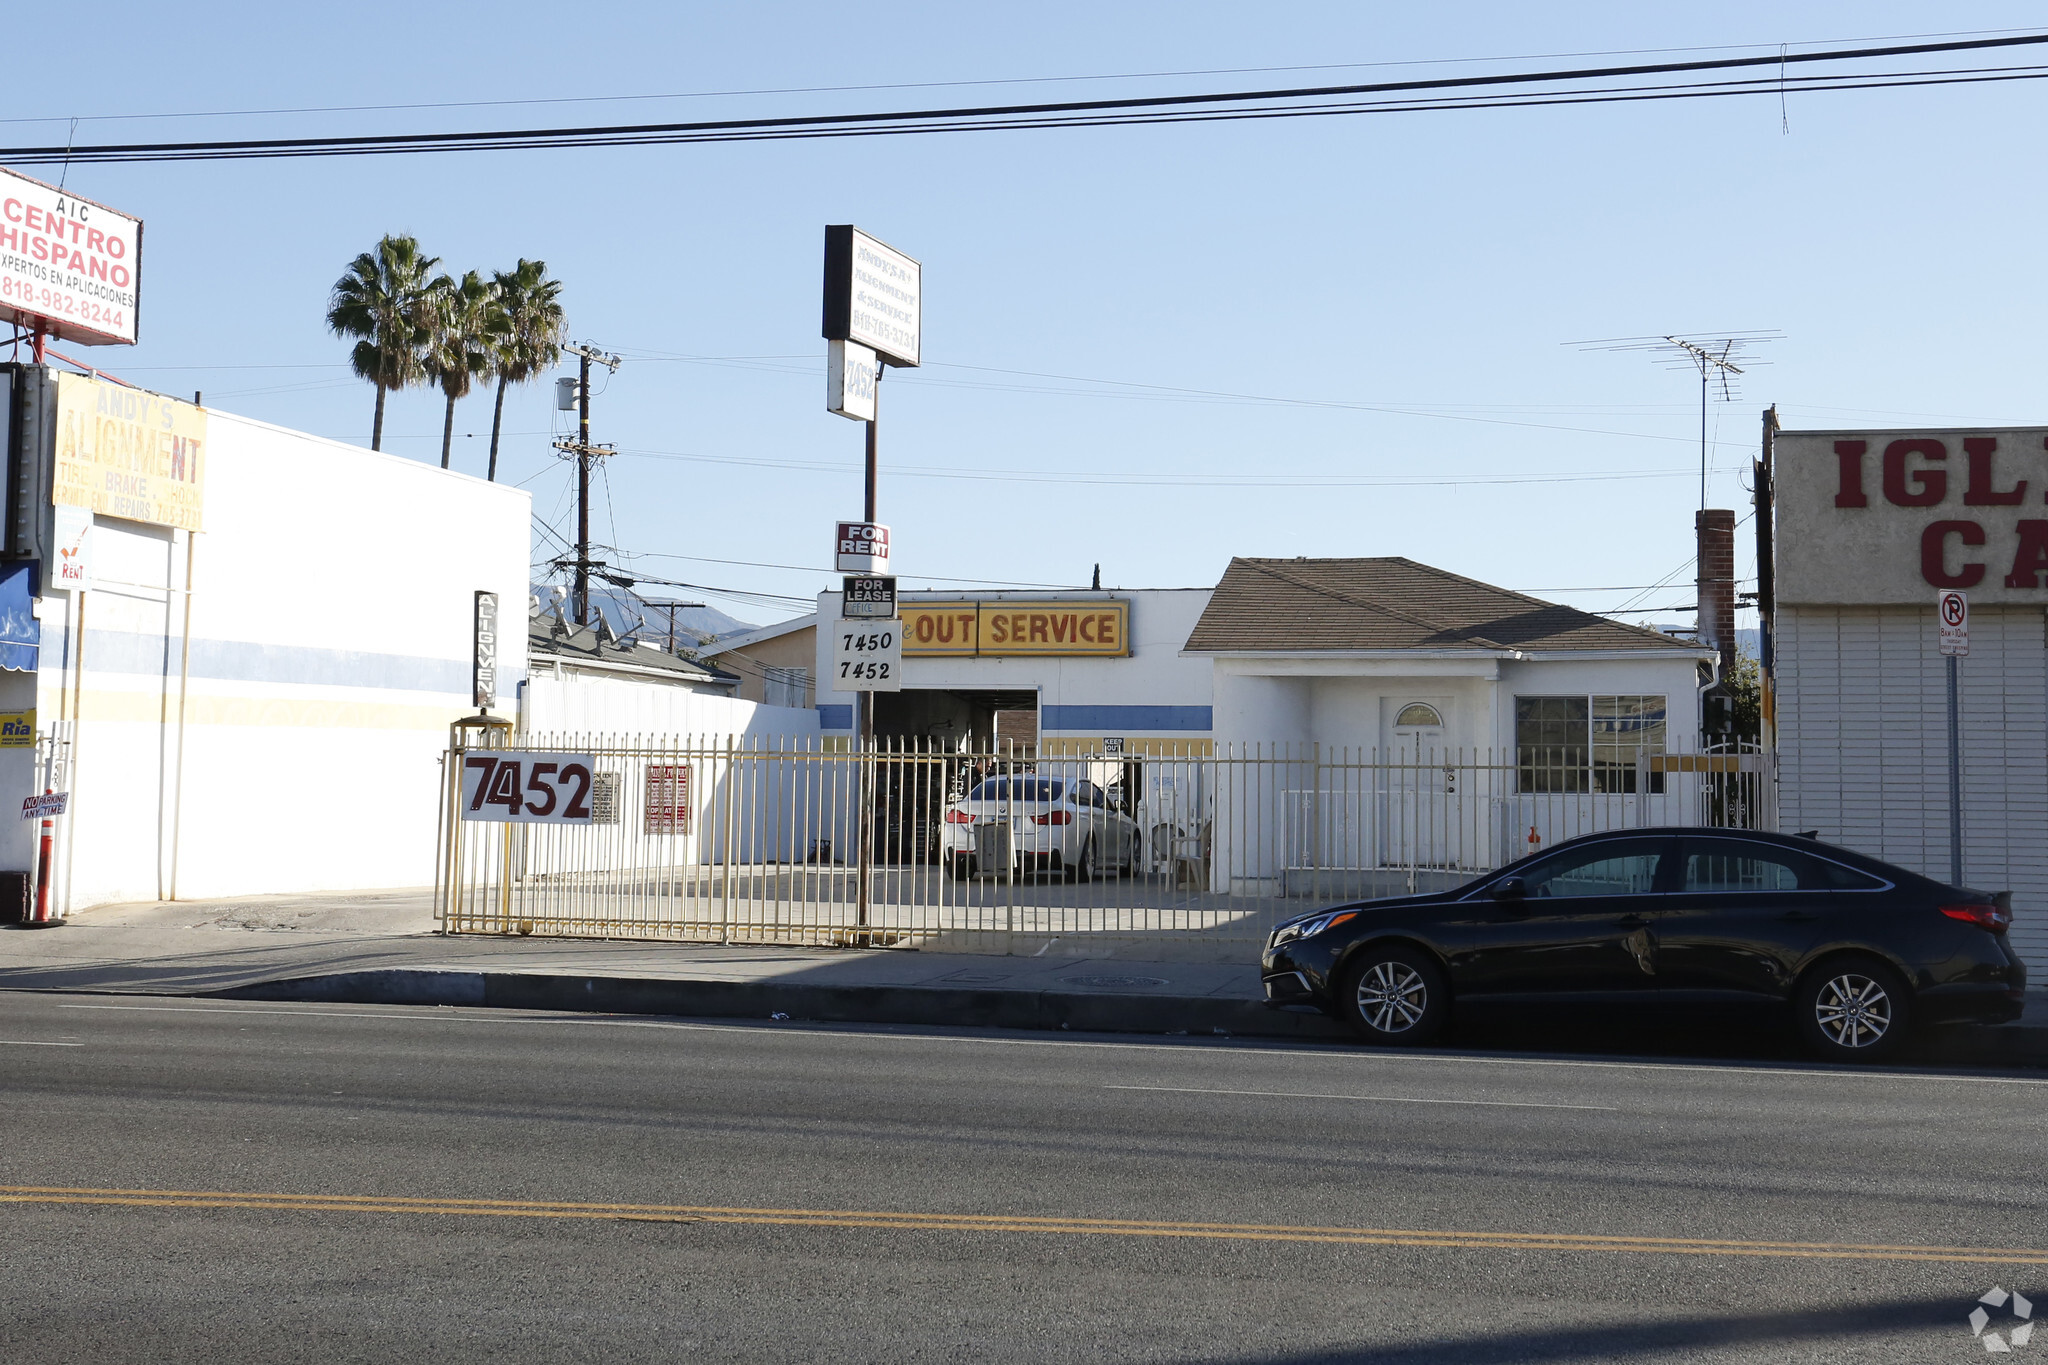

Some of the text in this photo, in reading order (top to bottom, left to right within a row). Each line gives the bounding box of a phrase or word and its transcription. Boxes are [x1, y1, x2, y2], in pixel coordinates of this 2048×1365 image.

[3, 198, 125, 259] CENTRO
[0, 223, 130, 288] HISPANO
[2, 276, 123, 329] 818-982-8244
[50, 270, 63, 286] EN
[66, 274, 134, 308] APLICACIONES
[847, 359, 874, 400] 7452
[96, 386, 174, 429] ANDY'S
[62, 409, 201, 484] ALIGNMENT
[105, 471, 147, 498] BRAKE
[1834, 437, 2048, 508] IGL
[114, 496, 150, 519] REPAIRS
[848, 525, 885, 543] FOR
[840, 540, 888, 558] RENT
[847, 591, 891, 601] LEASE
[854, 579, 883, 590] FOR
[846, 602, 873, 614] OFFICE
[843, 632, 892, 651] 7450
[916, 614, 976, 644] OUT
[991, 614, 1115, 643] SERVICE
[478, 594, 496, 703] ALIGNMEN
[841, 661, 890, 680] 7452
[1, 718, 31, 735] Ria
[24, 794, 65, 808] NO PARKING
[465, 757, 591, 818] 7452
[24, 804, 63, 819] ANY TIME
